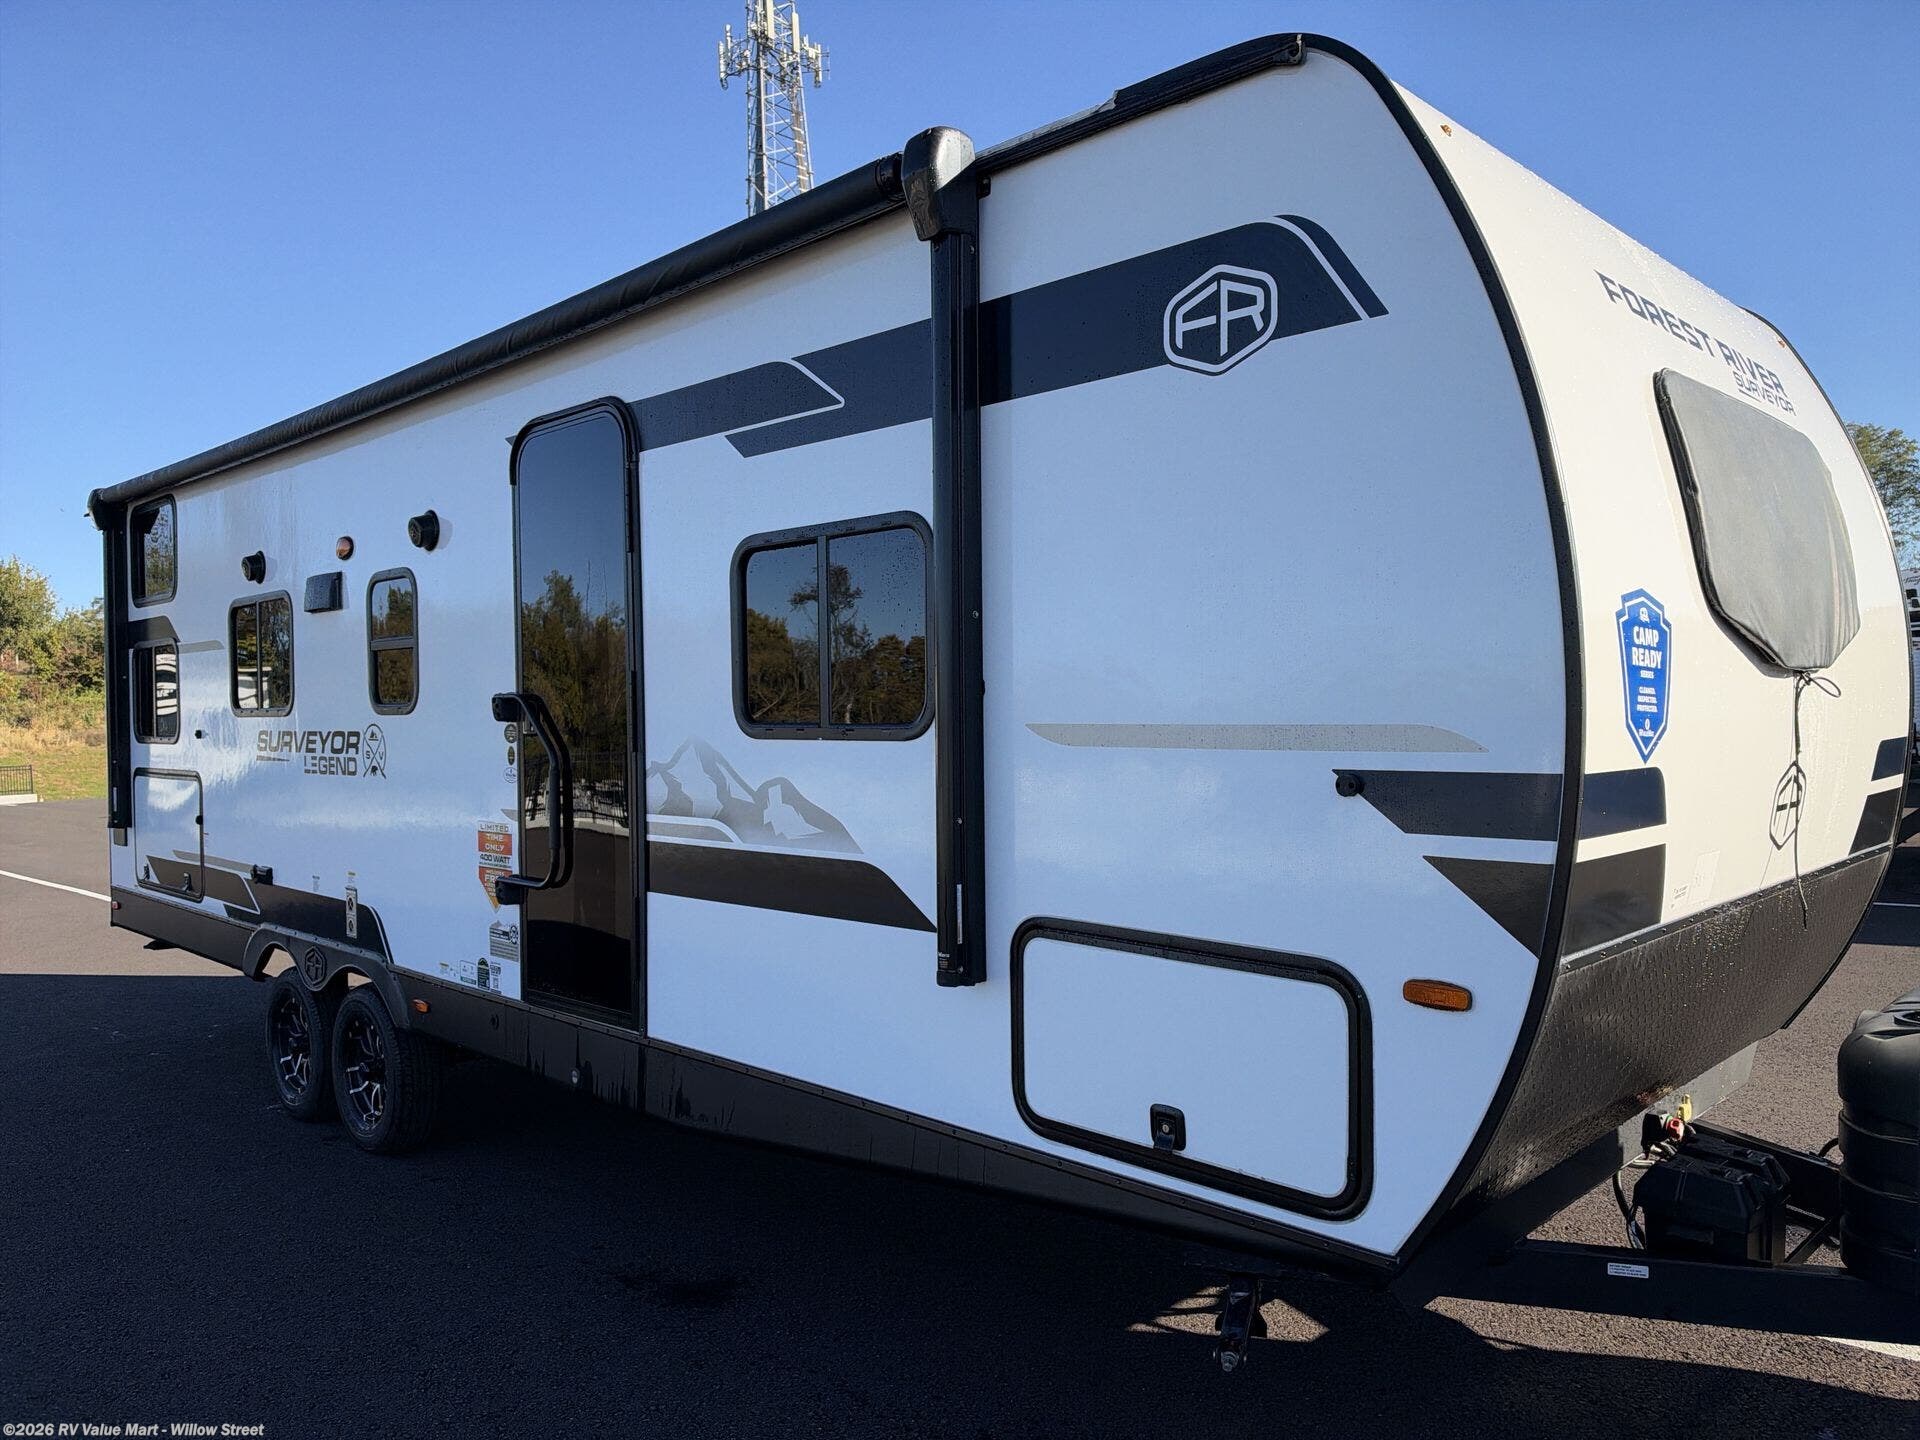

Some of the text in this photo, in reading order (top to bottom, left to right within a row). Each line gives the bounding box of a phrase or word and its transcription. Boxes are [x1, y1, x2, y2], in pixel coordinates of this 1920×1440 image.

[1593, 269, 1788, 397] FOREST RIVER
[1733, 371, 1797, 416] SURVEYOR
[1633, 625, 1660, 648] CAMP
[1632, 646, 1663, 669] READY
[257, 730, 360, 755] SURVEYOR
[303, 755, 358, 776] LEGEND
[480, 823, 510, 833] LIMITED
[486, 833, 505, 842] TIME
[484, 843, 505, 852] ONLY
[493, 854, 511, 865] WATT
